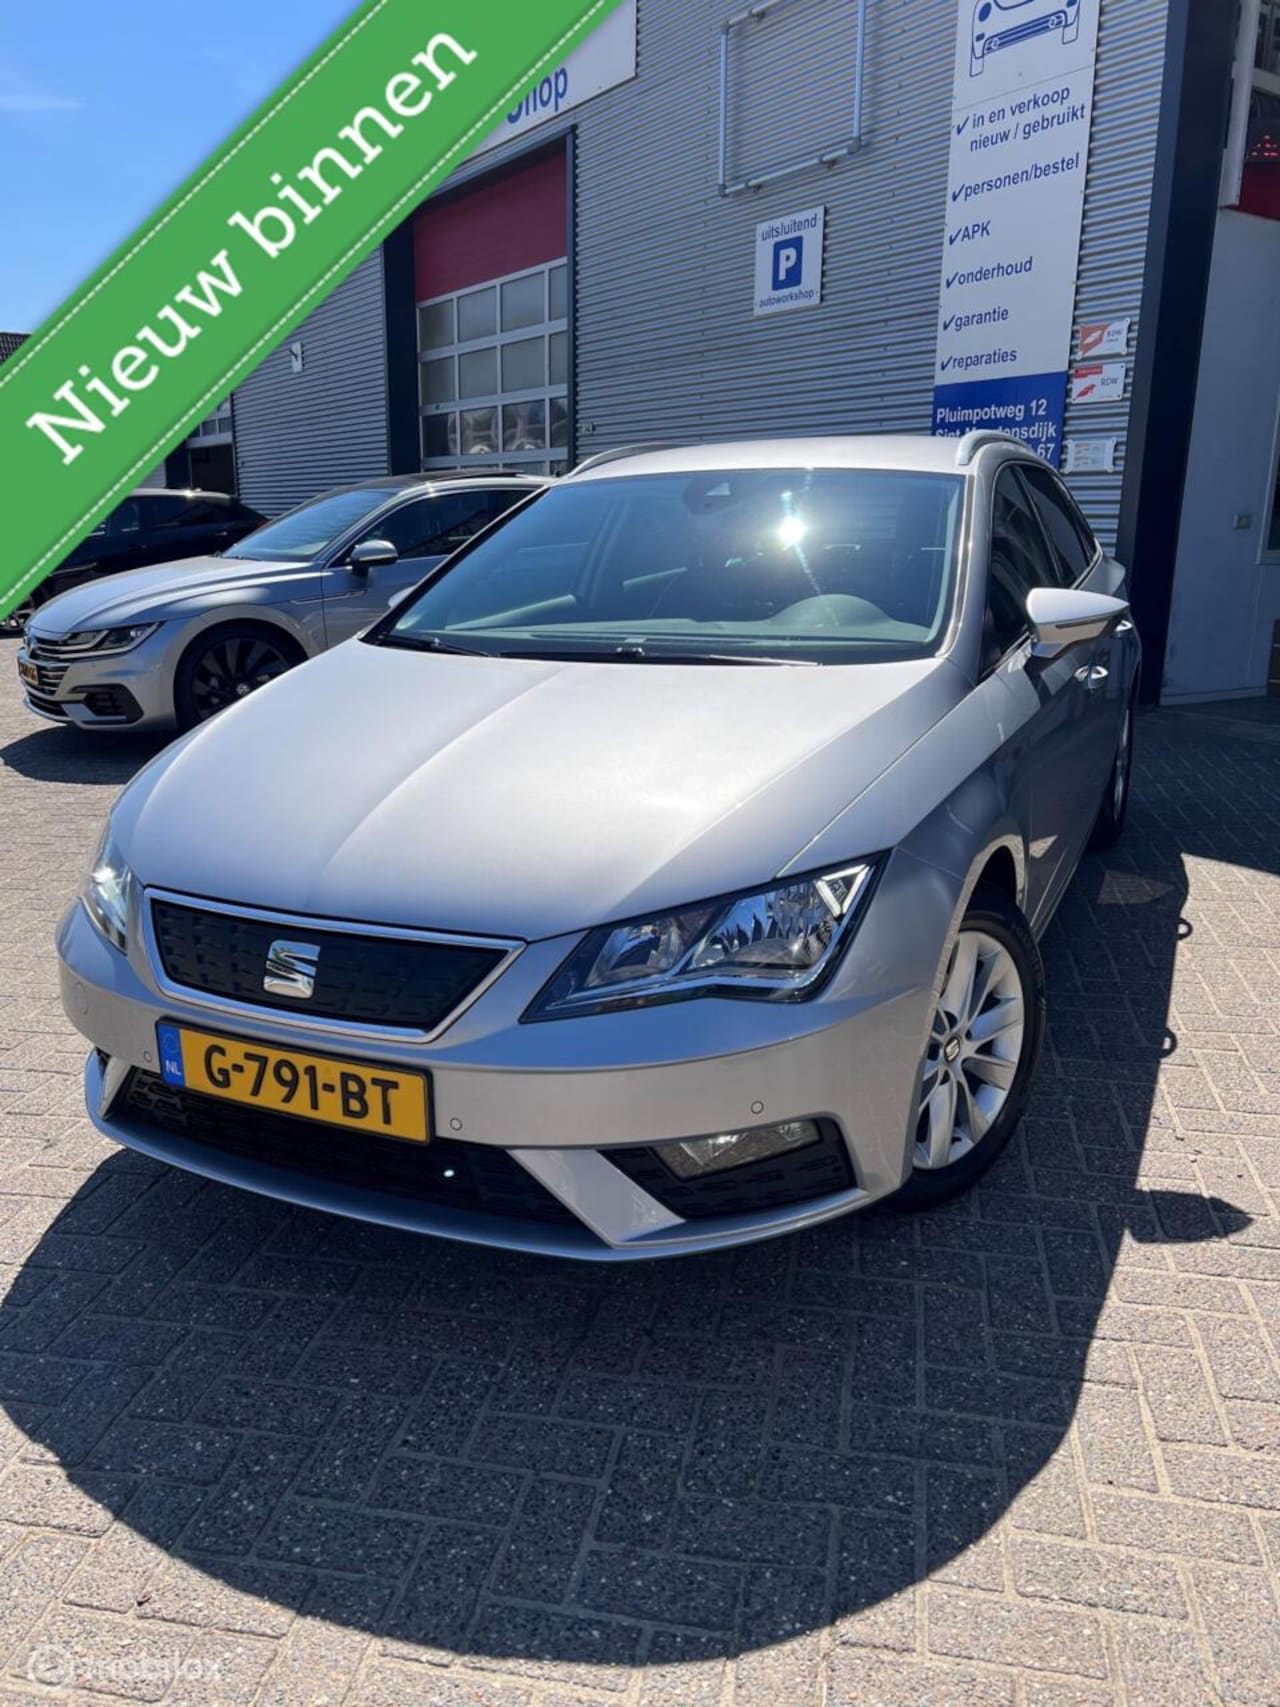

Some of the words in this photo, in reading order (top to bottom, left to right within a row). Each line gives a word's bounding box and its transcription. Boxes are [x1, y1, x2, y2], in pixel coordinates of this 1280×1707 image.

[972, 113, 985, 129] in
[988, 107, 1006, 124] en
[1010, 87, 1071, 117] verkoop
[970, 127, 1011, 152] nieuw
[1022, 103, 1086, 141] gebruikt
[963, 152, 1080, 201] personen/bestel
[761, 213, 818, 241] uitsluitend
[960, 220, 992, 243] APK
[778, 247, 797, 281] P
[957, 256, 1033, 285] onderhoud
[954, 306, 1009, 332] garantie
[951, 348, 1018, 370] reparaties
[936, 402, 1025, 425] Pluimpotweg
[1029, 399, 1048, 416] 12
[165, 1060, 182, 1077] NL
[203, 1044, 400, 1126] G-791-BT
